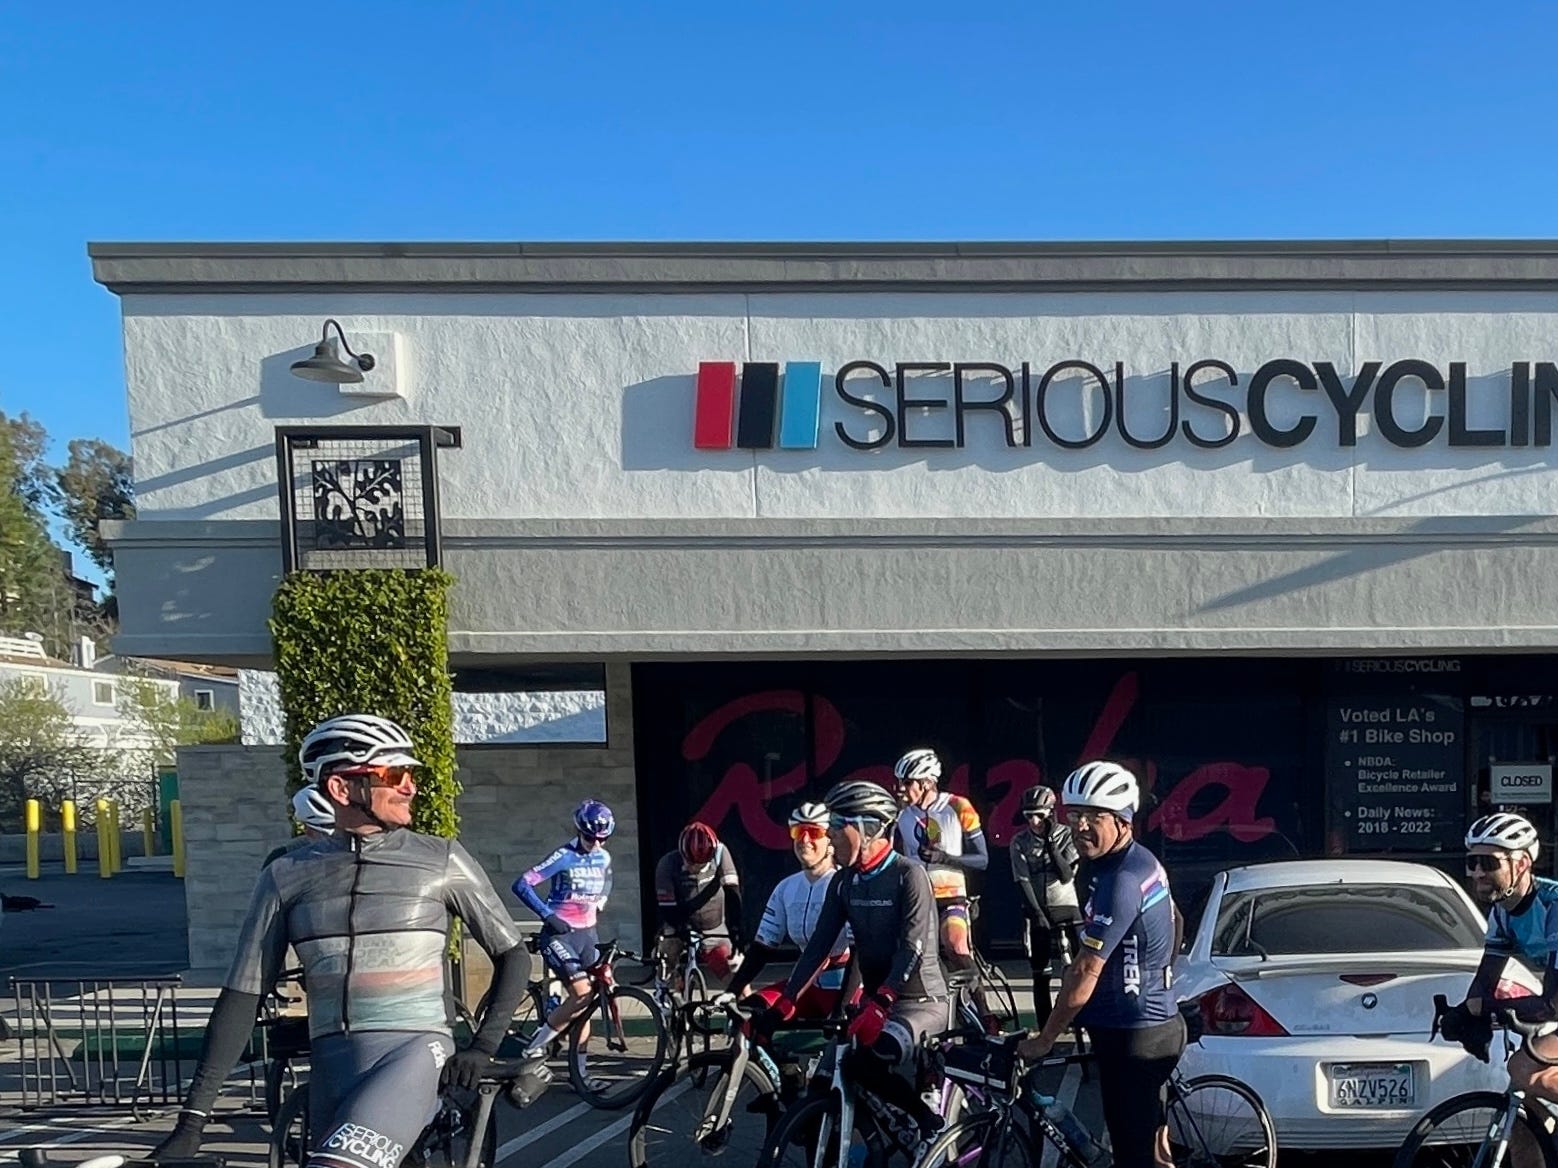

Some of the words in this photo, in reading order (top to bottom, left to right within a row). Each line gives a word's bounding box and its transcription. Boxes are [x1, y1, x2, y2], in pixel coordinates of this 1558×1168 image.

[1340, 708, 1390, 722] Voted
[1396, 707, 1436, 722] LA's
[1340, 729, 1358, 743] #1
[1365, 729, 1404, 743] Bike
[1408, 729, 1455, 746] Shop
[1358, 769, 1399, 781] Bicycle
[1402, 769, 1446, 779] Retailer
[1501, 775, 1543, 787] CLOSED
[1358, 782, 1418, 793] Excellence
[1420, 782, 1457, 792] Award
[1358, 807, 1391, 820] Daily
[1394, 807, 1435, 818] News:
[1358, 822, 1389, 833] 2018
[1400, 821, 1431, 833] 2022
[1122, 934, 1141, 996] TREK
[1338, 1079, 1408, 1099] 6NZV526
[340, 1122, 403, 1160] SERIOUS
